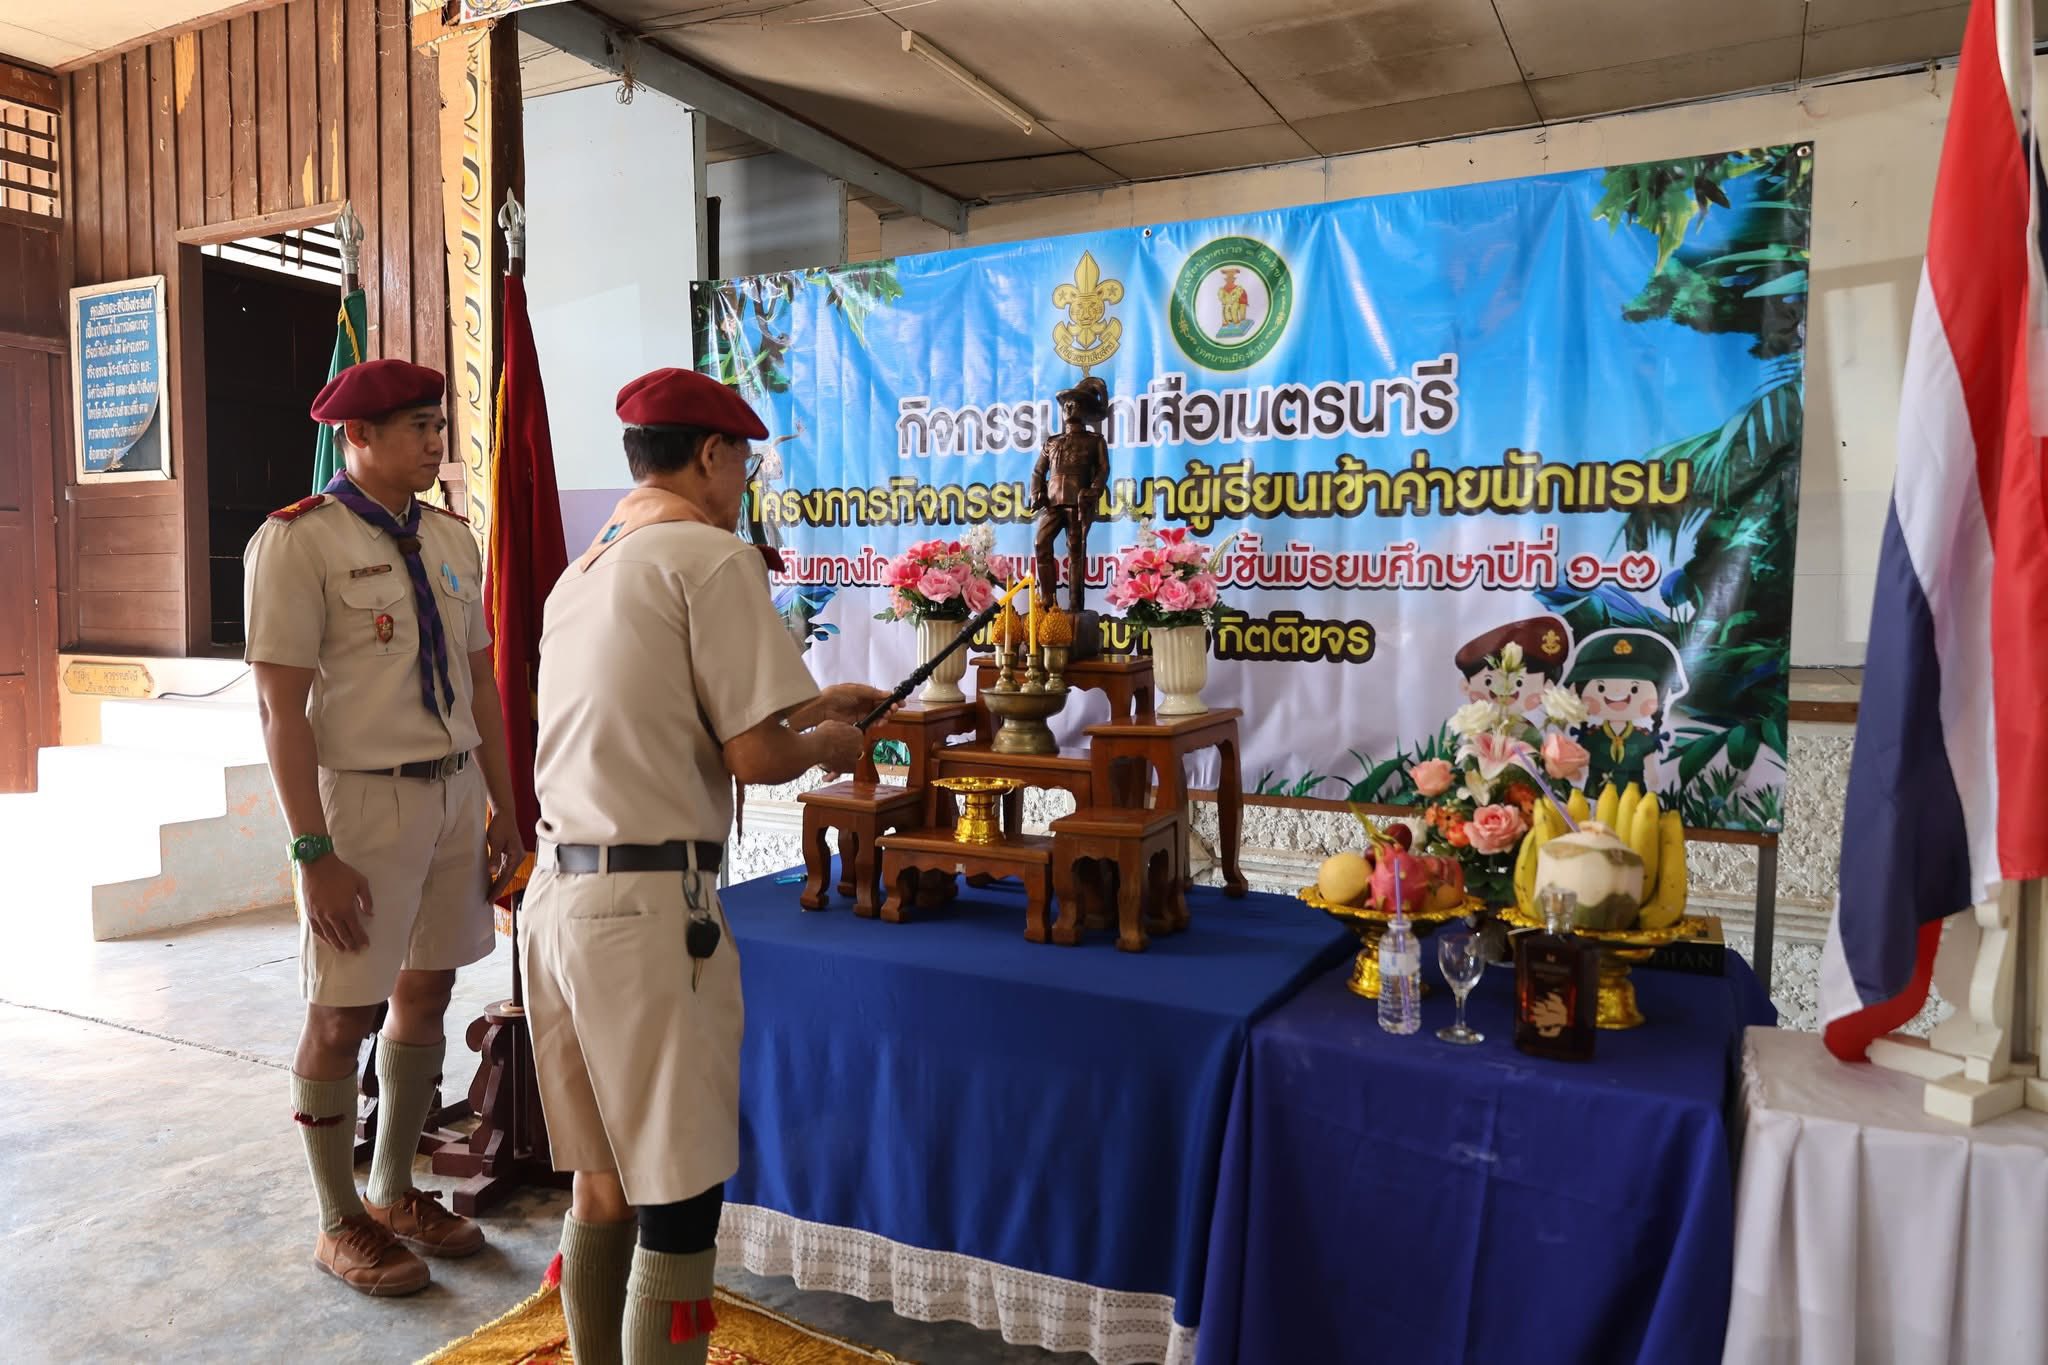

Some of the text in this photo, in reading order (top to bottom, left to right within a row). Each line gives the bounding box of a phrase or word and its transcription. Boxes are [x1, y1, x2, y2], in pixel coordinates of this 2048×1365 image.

[1571, 555, 1656, 585] ๑-๓
[1218, 616, 1370, 656] กิตติขจร
